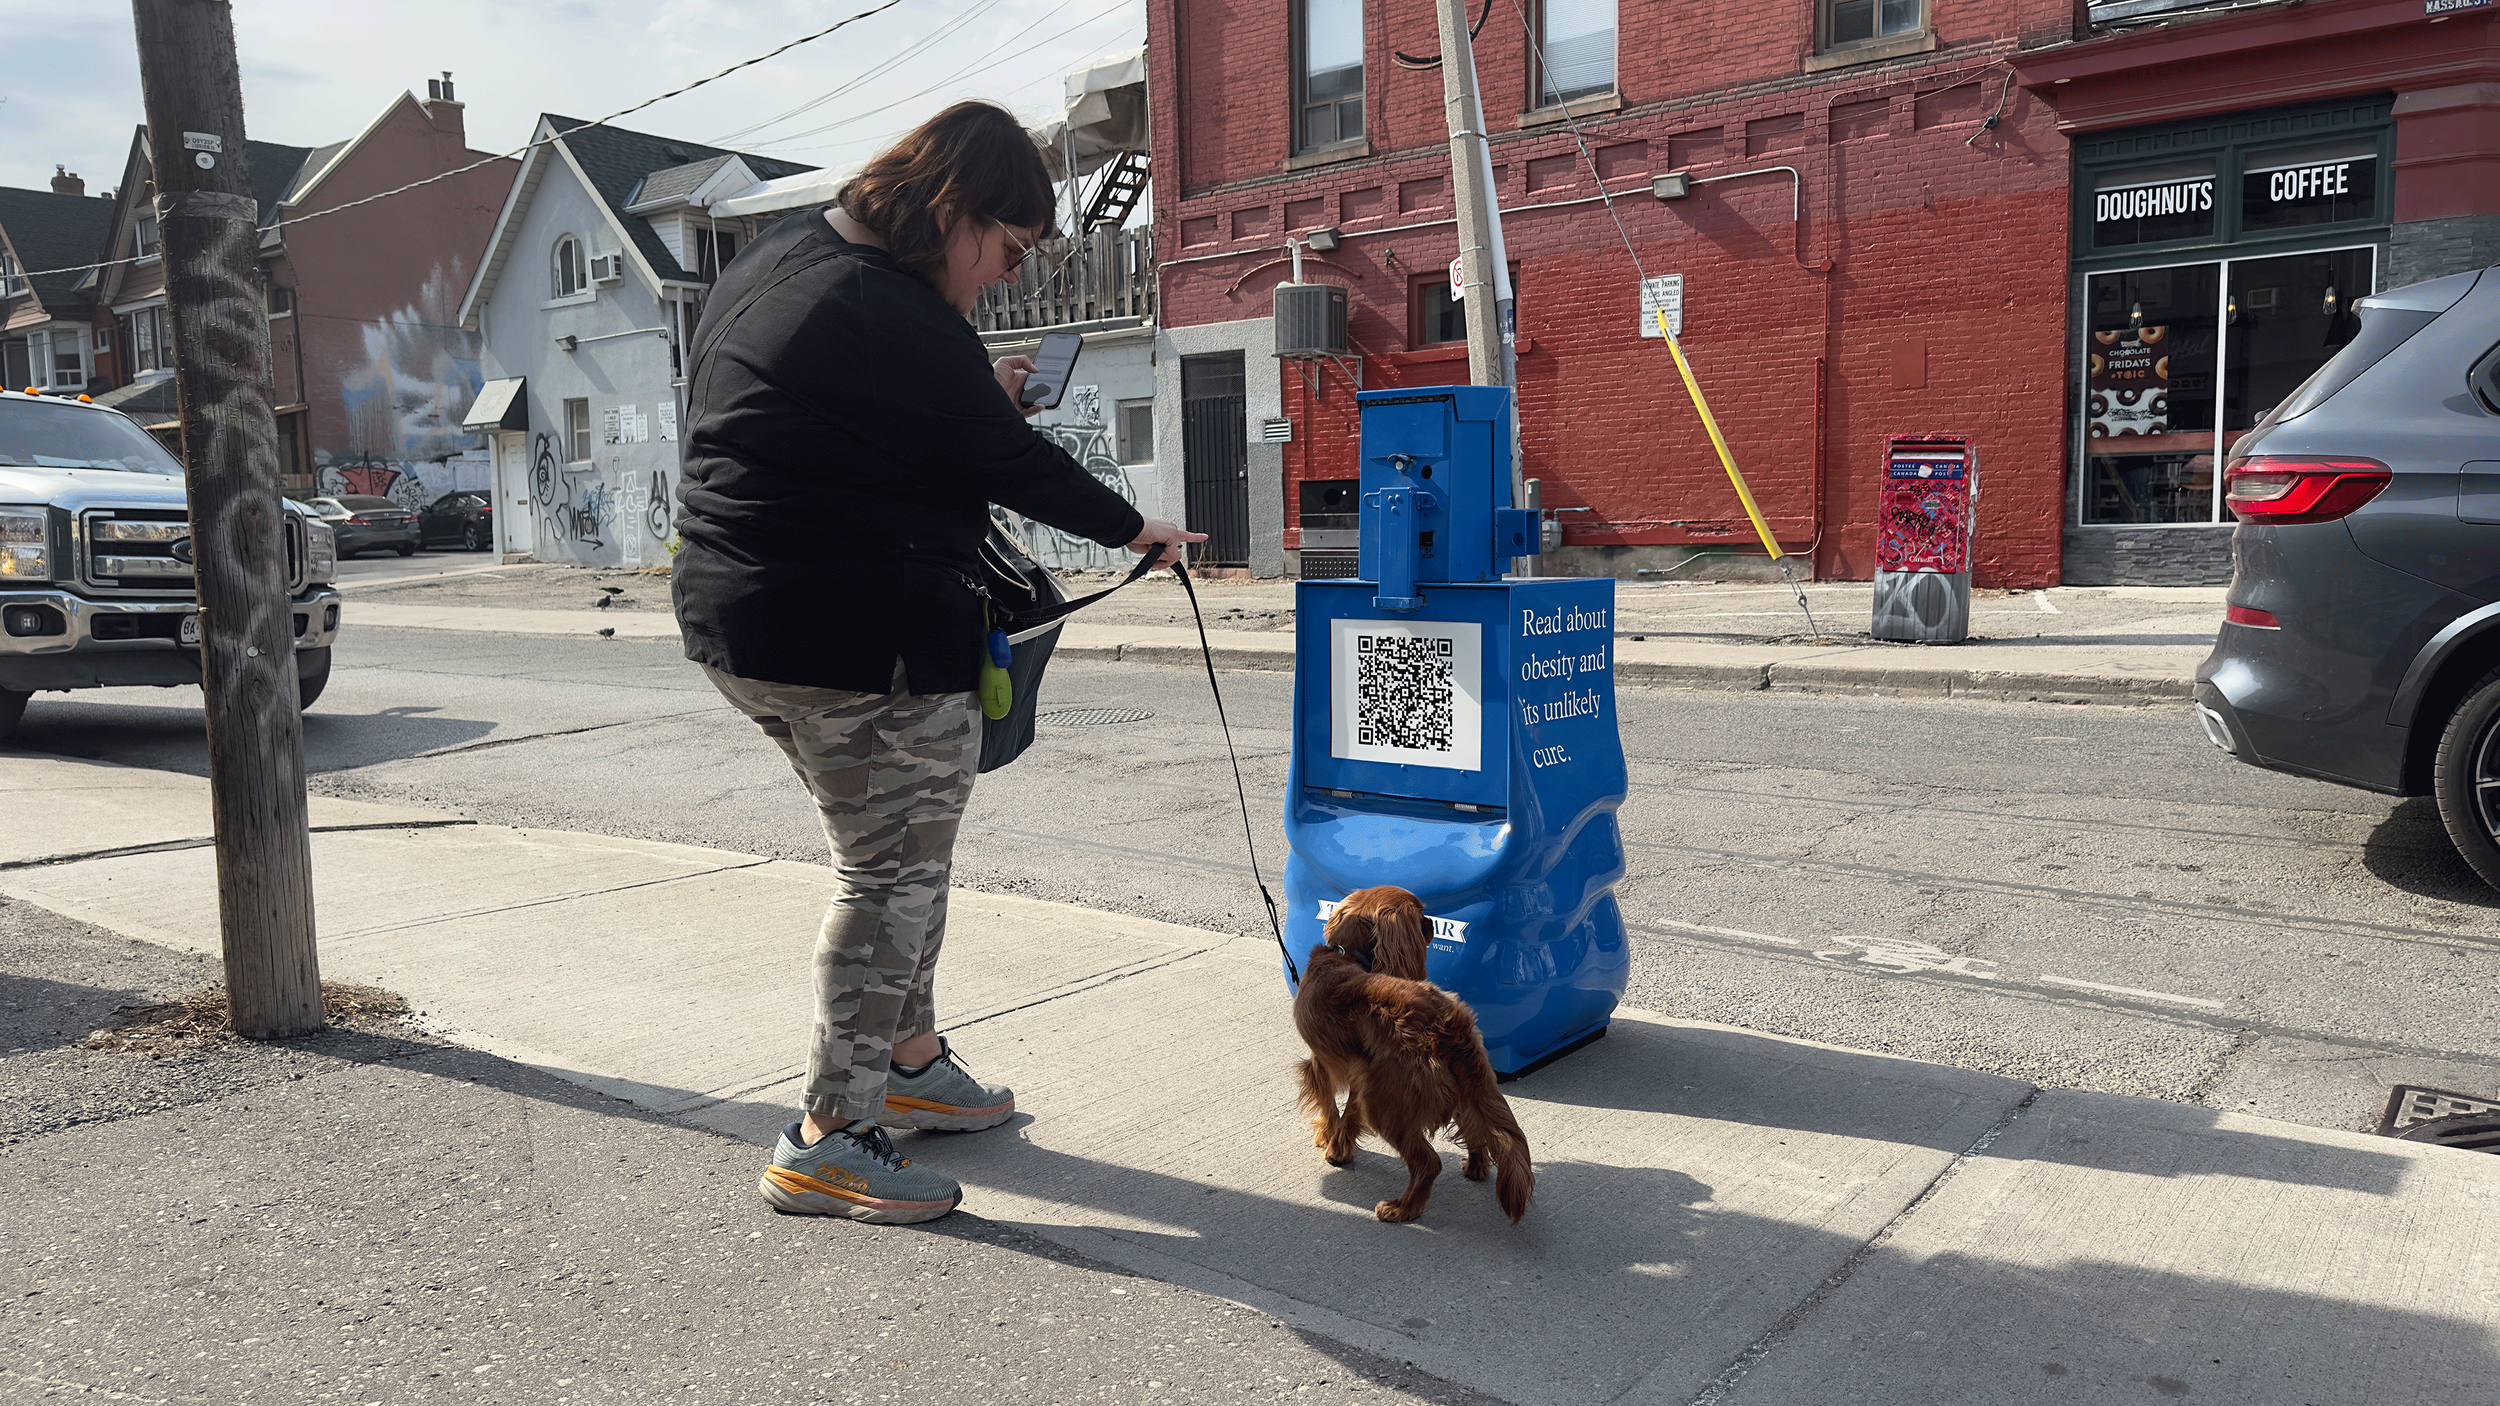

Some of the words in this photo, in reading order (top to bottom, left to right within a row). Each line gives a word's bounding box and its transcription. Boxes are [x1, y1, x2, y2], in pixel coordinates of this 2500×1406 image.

[2097, 181, 2213, 223] DOUGHNUTS
[2270, 164, 2349, 202] COFFEE
[2108, 358, 2150, 370] FRIDAYS
[2109, 347, 2151, 357] CHOCOLATE
[1522, 607, 1562, 637] Read
[1566, 605, 1607, 633] about
[1521, 650, 1575, 681] obesity
[1579, 645, 1606, 672] and
[1522, 698, 1540, 726] its
[1543, 688, 1601, 721] unlikely
[1533, 744, 1572, 769] cure.
[1432, 943, 1455, 953] want.
[816, 1162, 870, 1195] HOKA
